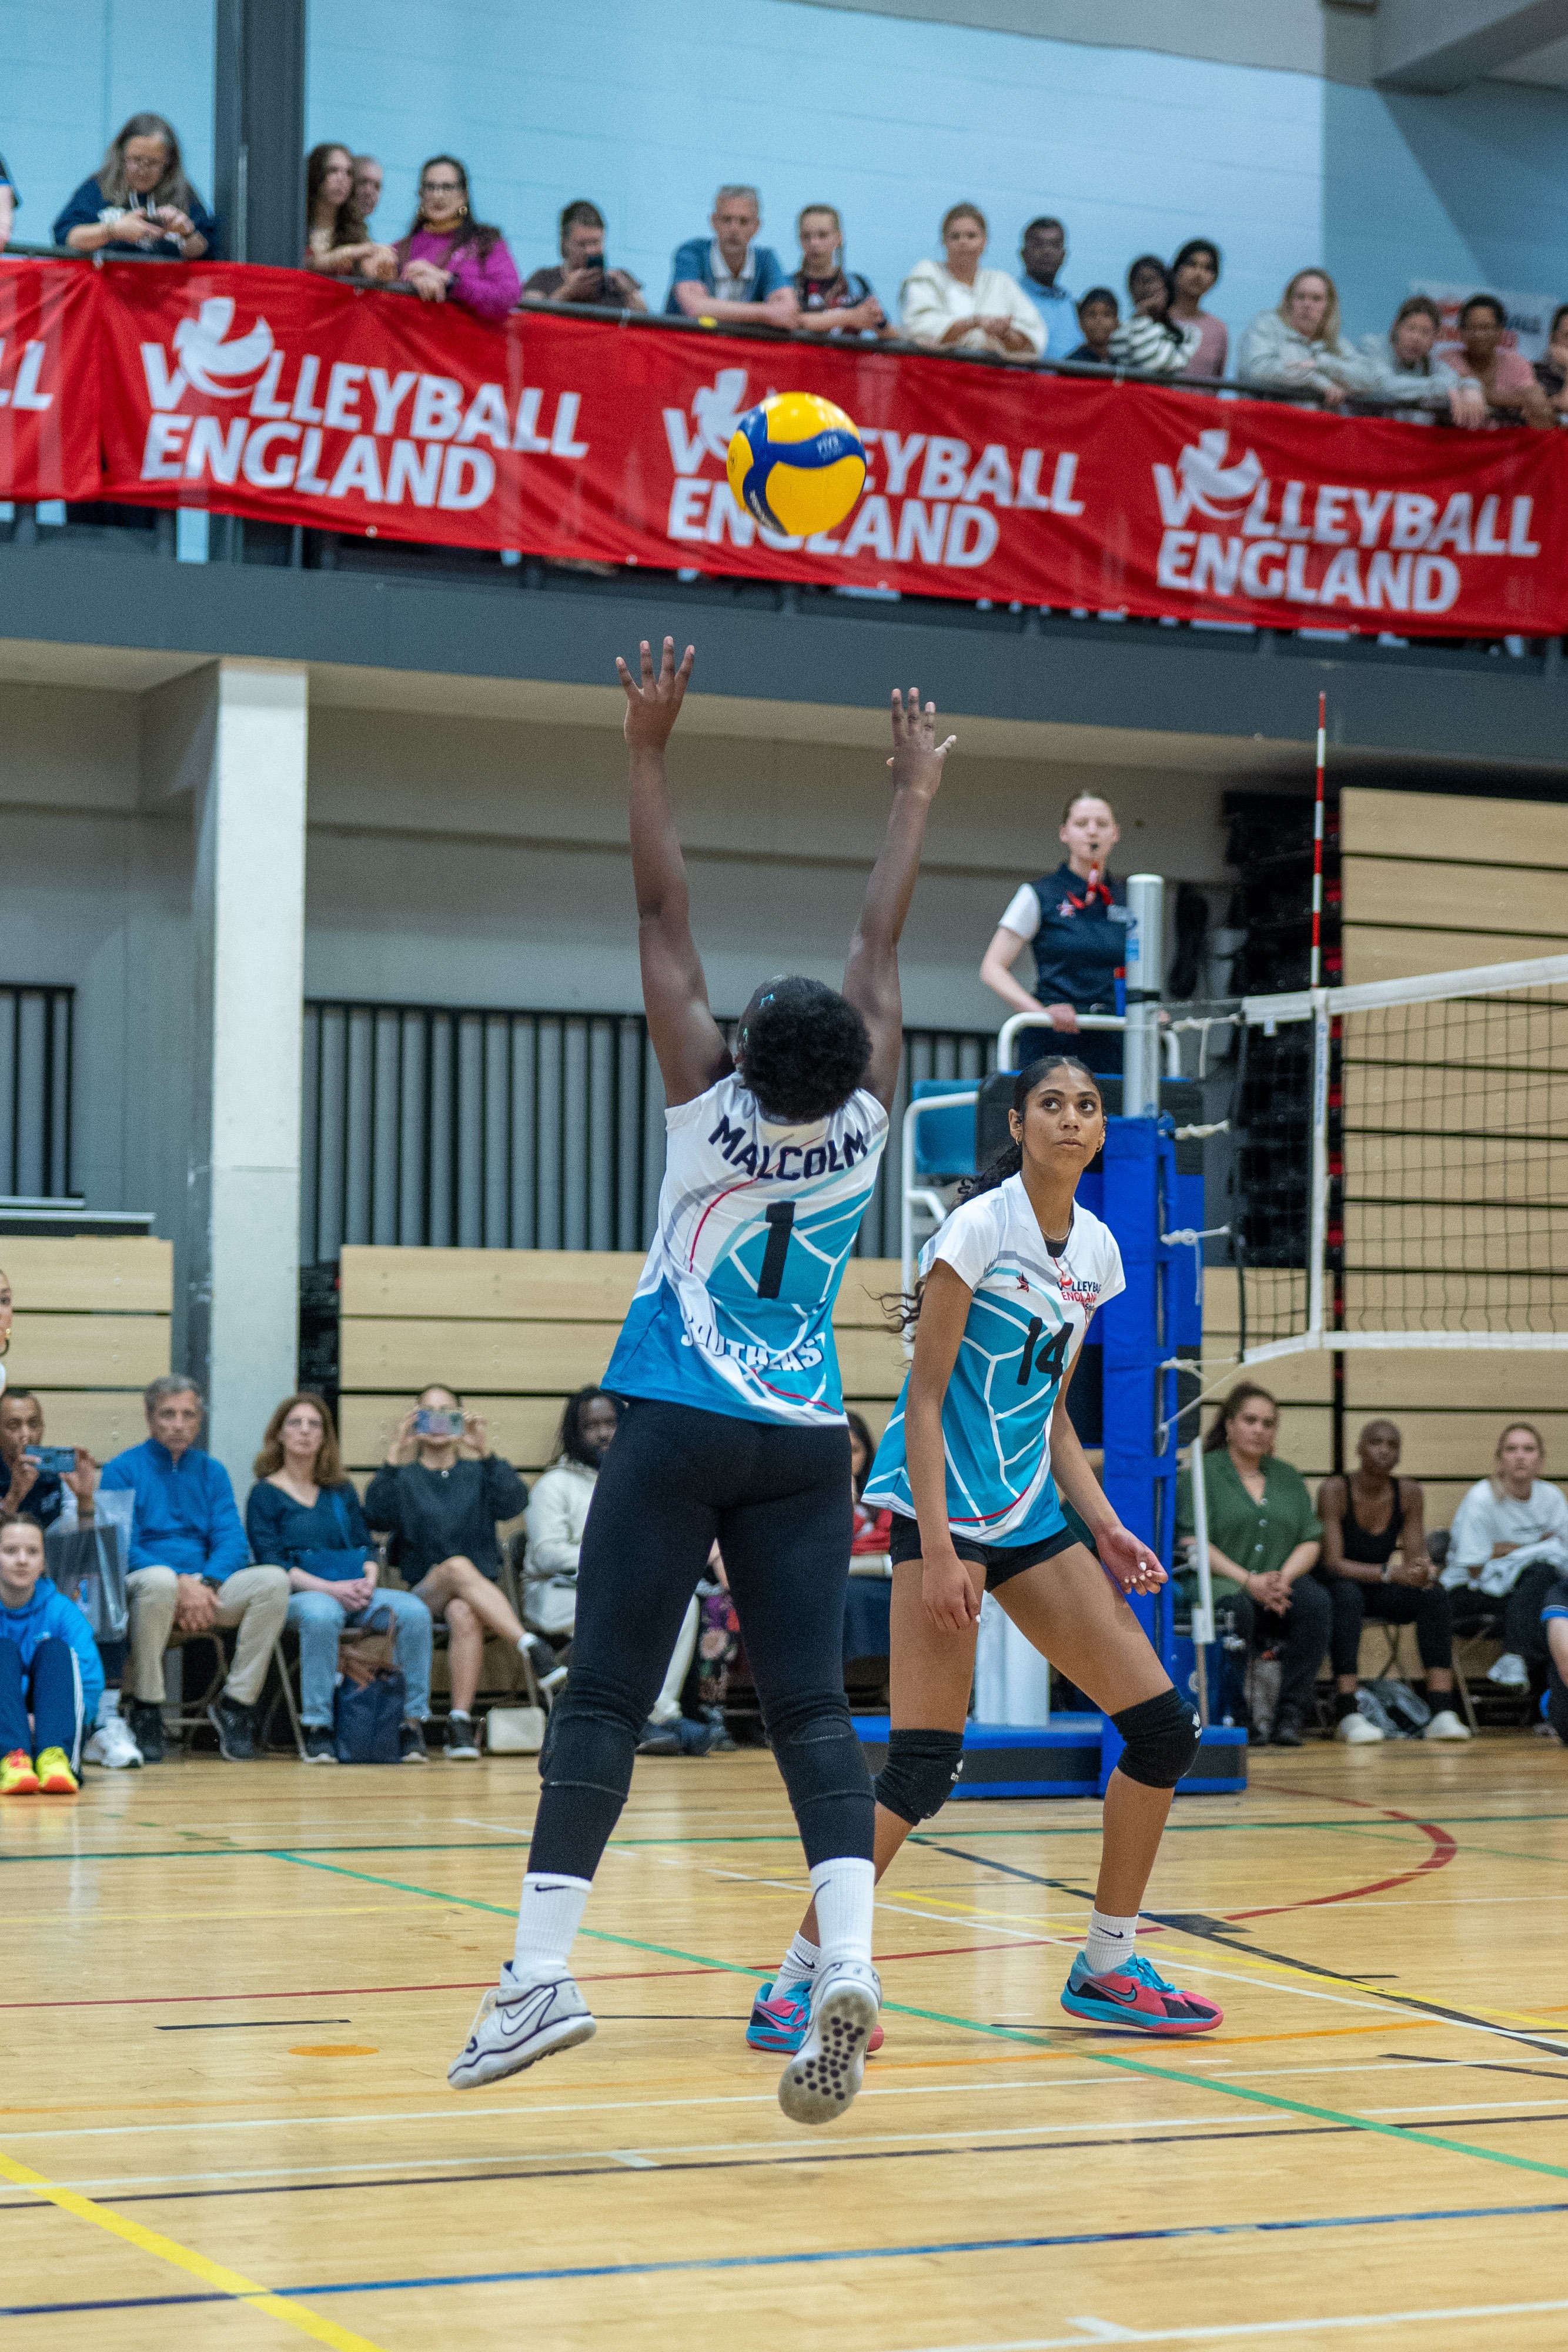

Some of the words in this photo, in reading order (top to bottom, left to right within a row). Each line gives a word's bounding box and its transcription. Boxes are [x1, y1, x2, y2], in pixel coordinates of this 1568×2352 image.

[140, 412, 496, 510] ENGLAND
[1157, 530, 1460, 613] ENGLAND
[708, 1114, 868, 1181] MALCOLM
[758, 1201, 796, 1299] 1
[1017, 1316, 1075, 1389] 14
